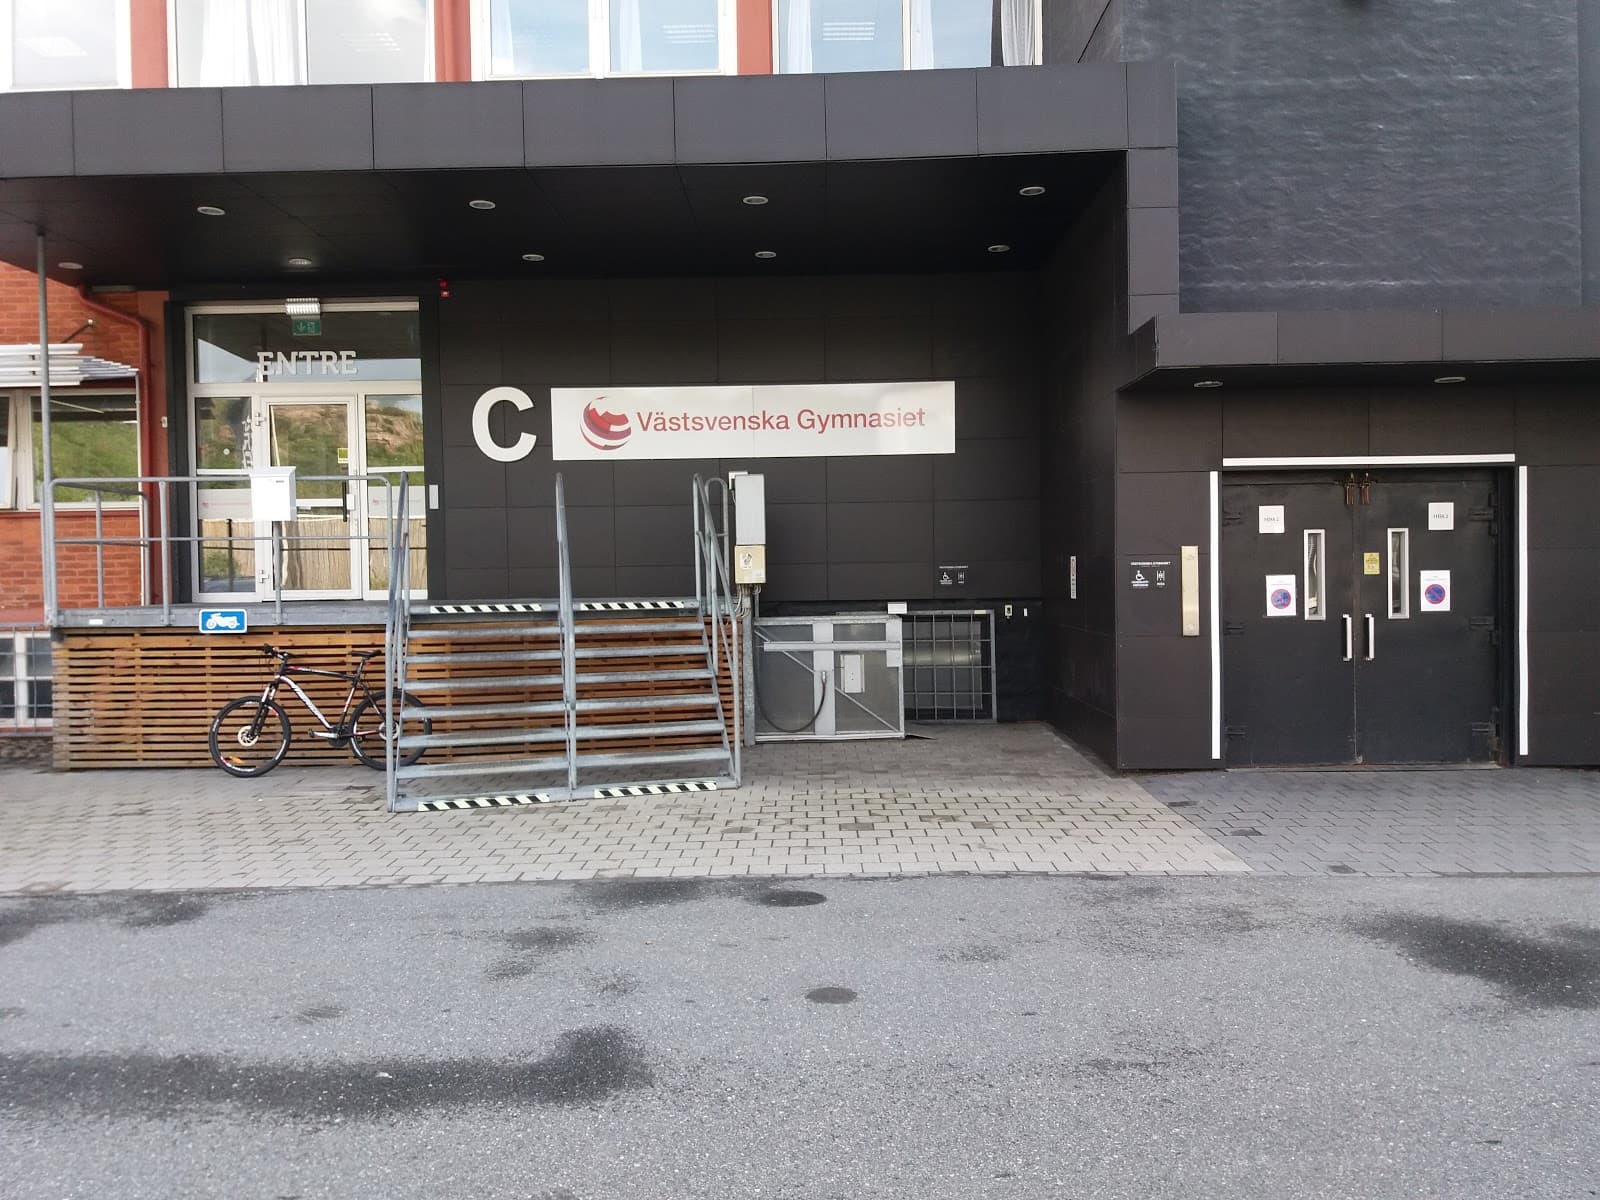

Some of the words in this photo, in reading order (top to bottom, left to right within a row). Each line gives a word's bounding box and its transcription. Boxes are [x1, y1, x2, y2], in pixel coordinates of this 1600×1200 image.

[257, 351, 357, 376] ENTRE
[472, 386, 537, 462] C
[637, 410, 790, 432] Västsvenska
[797, 407, 926, 434] Gymnasiet
